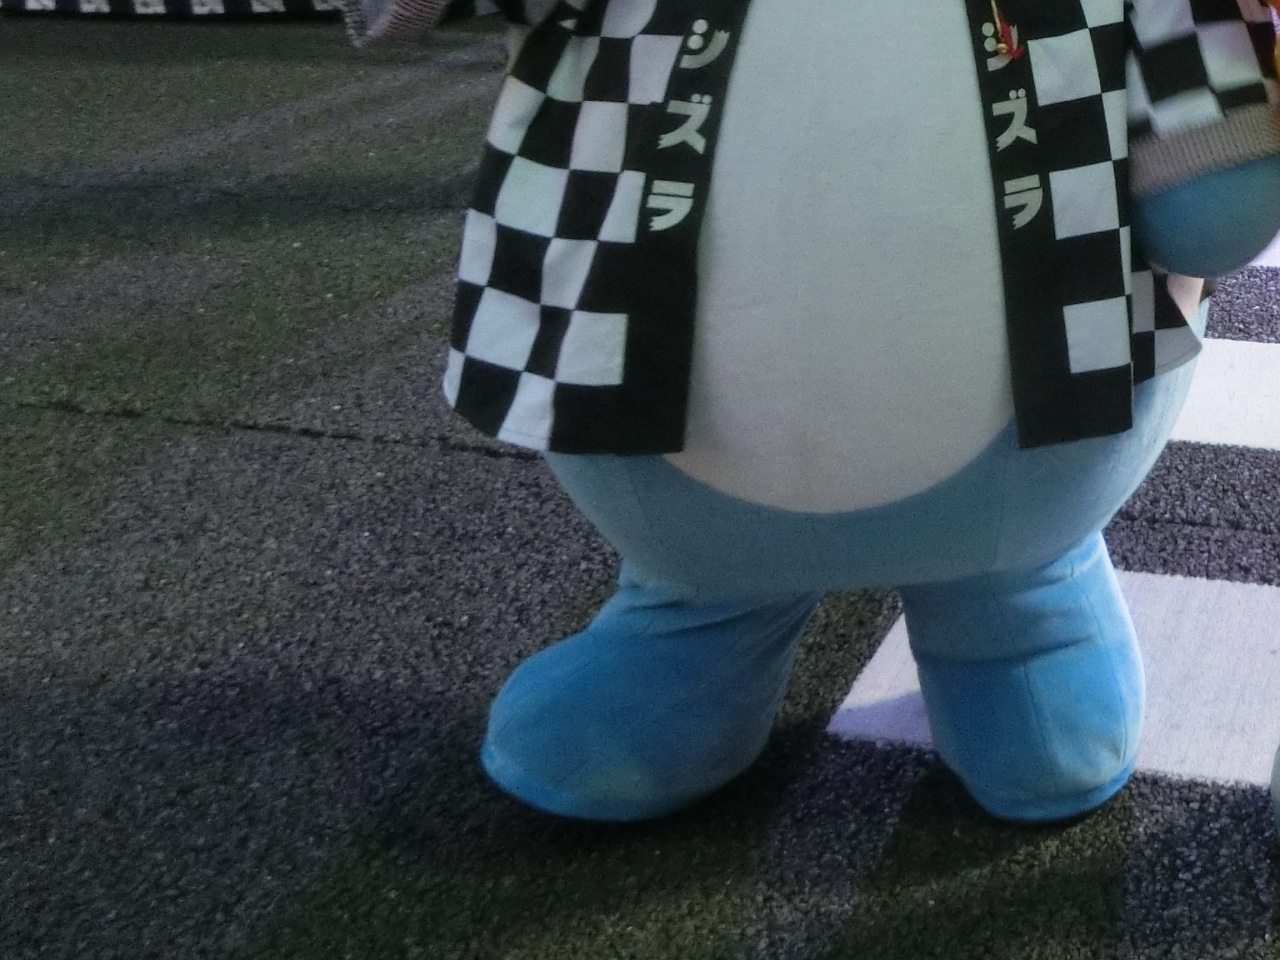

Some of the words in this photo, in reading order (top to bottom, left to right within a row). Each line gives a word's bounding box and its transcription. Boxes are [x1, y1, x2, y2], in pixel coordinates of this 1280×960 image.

[646, 18, 731, 232] シズラ
[981, 21, 1044, 230] シズラ
